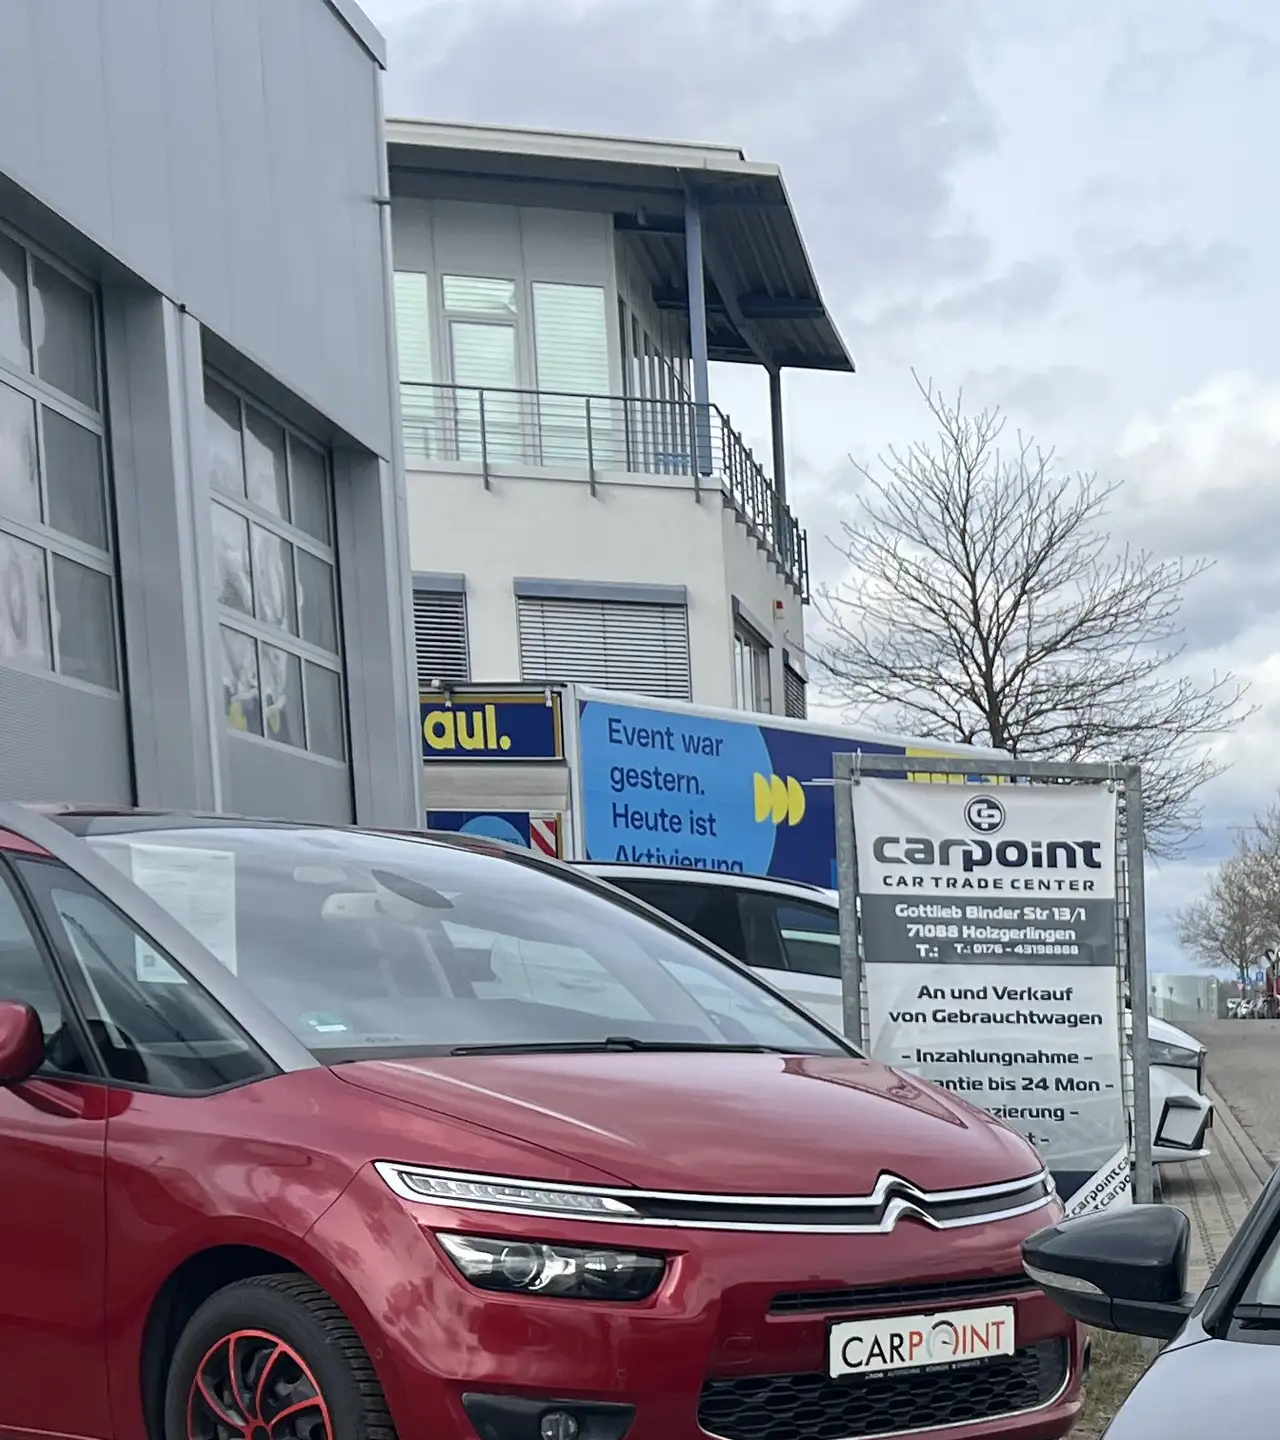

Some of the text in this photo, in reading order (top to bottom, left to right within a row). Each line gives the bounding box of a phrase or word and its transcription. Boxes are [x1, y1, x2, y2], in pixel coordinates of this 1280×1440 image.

[424, 704, 511, 750] aul.
[608, 718, 723, 757] Event war
[610, 764, 705, 795] gestern.
[612, 802, 717, 837] Heute ist
[873, 836, 1101, 871] carpoint
[883, 875, 1094, 891] CAR TRADE CENTER
[895, 904, 1086, 923] Gottlieb Binder Str 13/1
[906, 924, 1076, 942] 71088 Holzgerlingen
[973, 943, 1003, 954] 0176
[917, 985, 1073, 1001] An und Verkauf
[889, 1009, 1103, 1028] von Gebrauchtwagen
[915, 1049, 1079, 1066] Inzahlungnahme
[988, 1076, 1016, 1091] bis
[1021, 1077, 1049, 1091] 24
[1054, 1077, 1100, 1092] Mon
